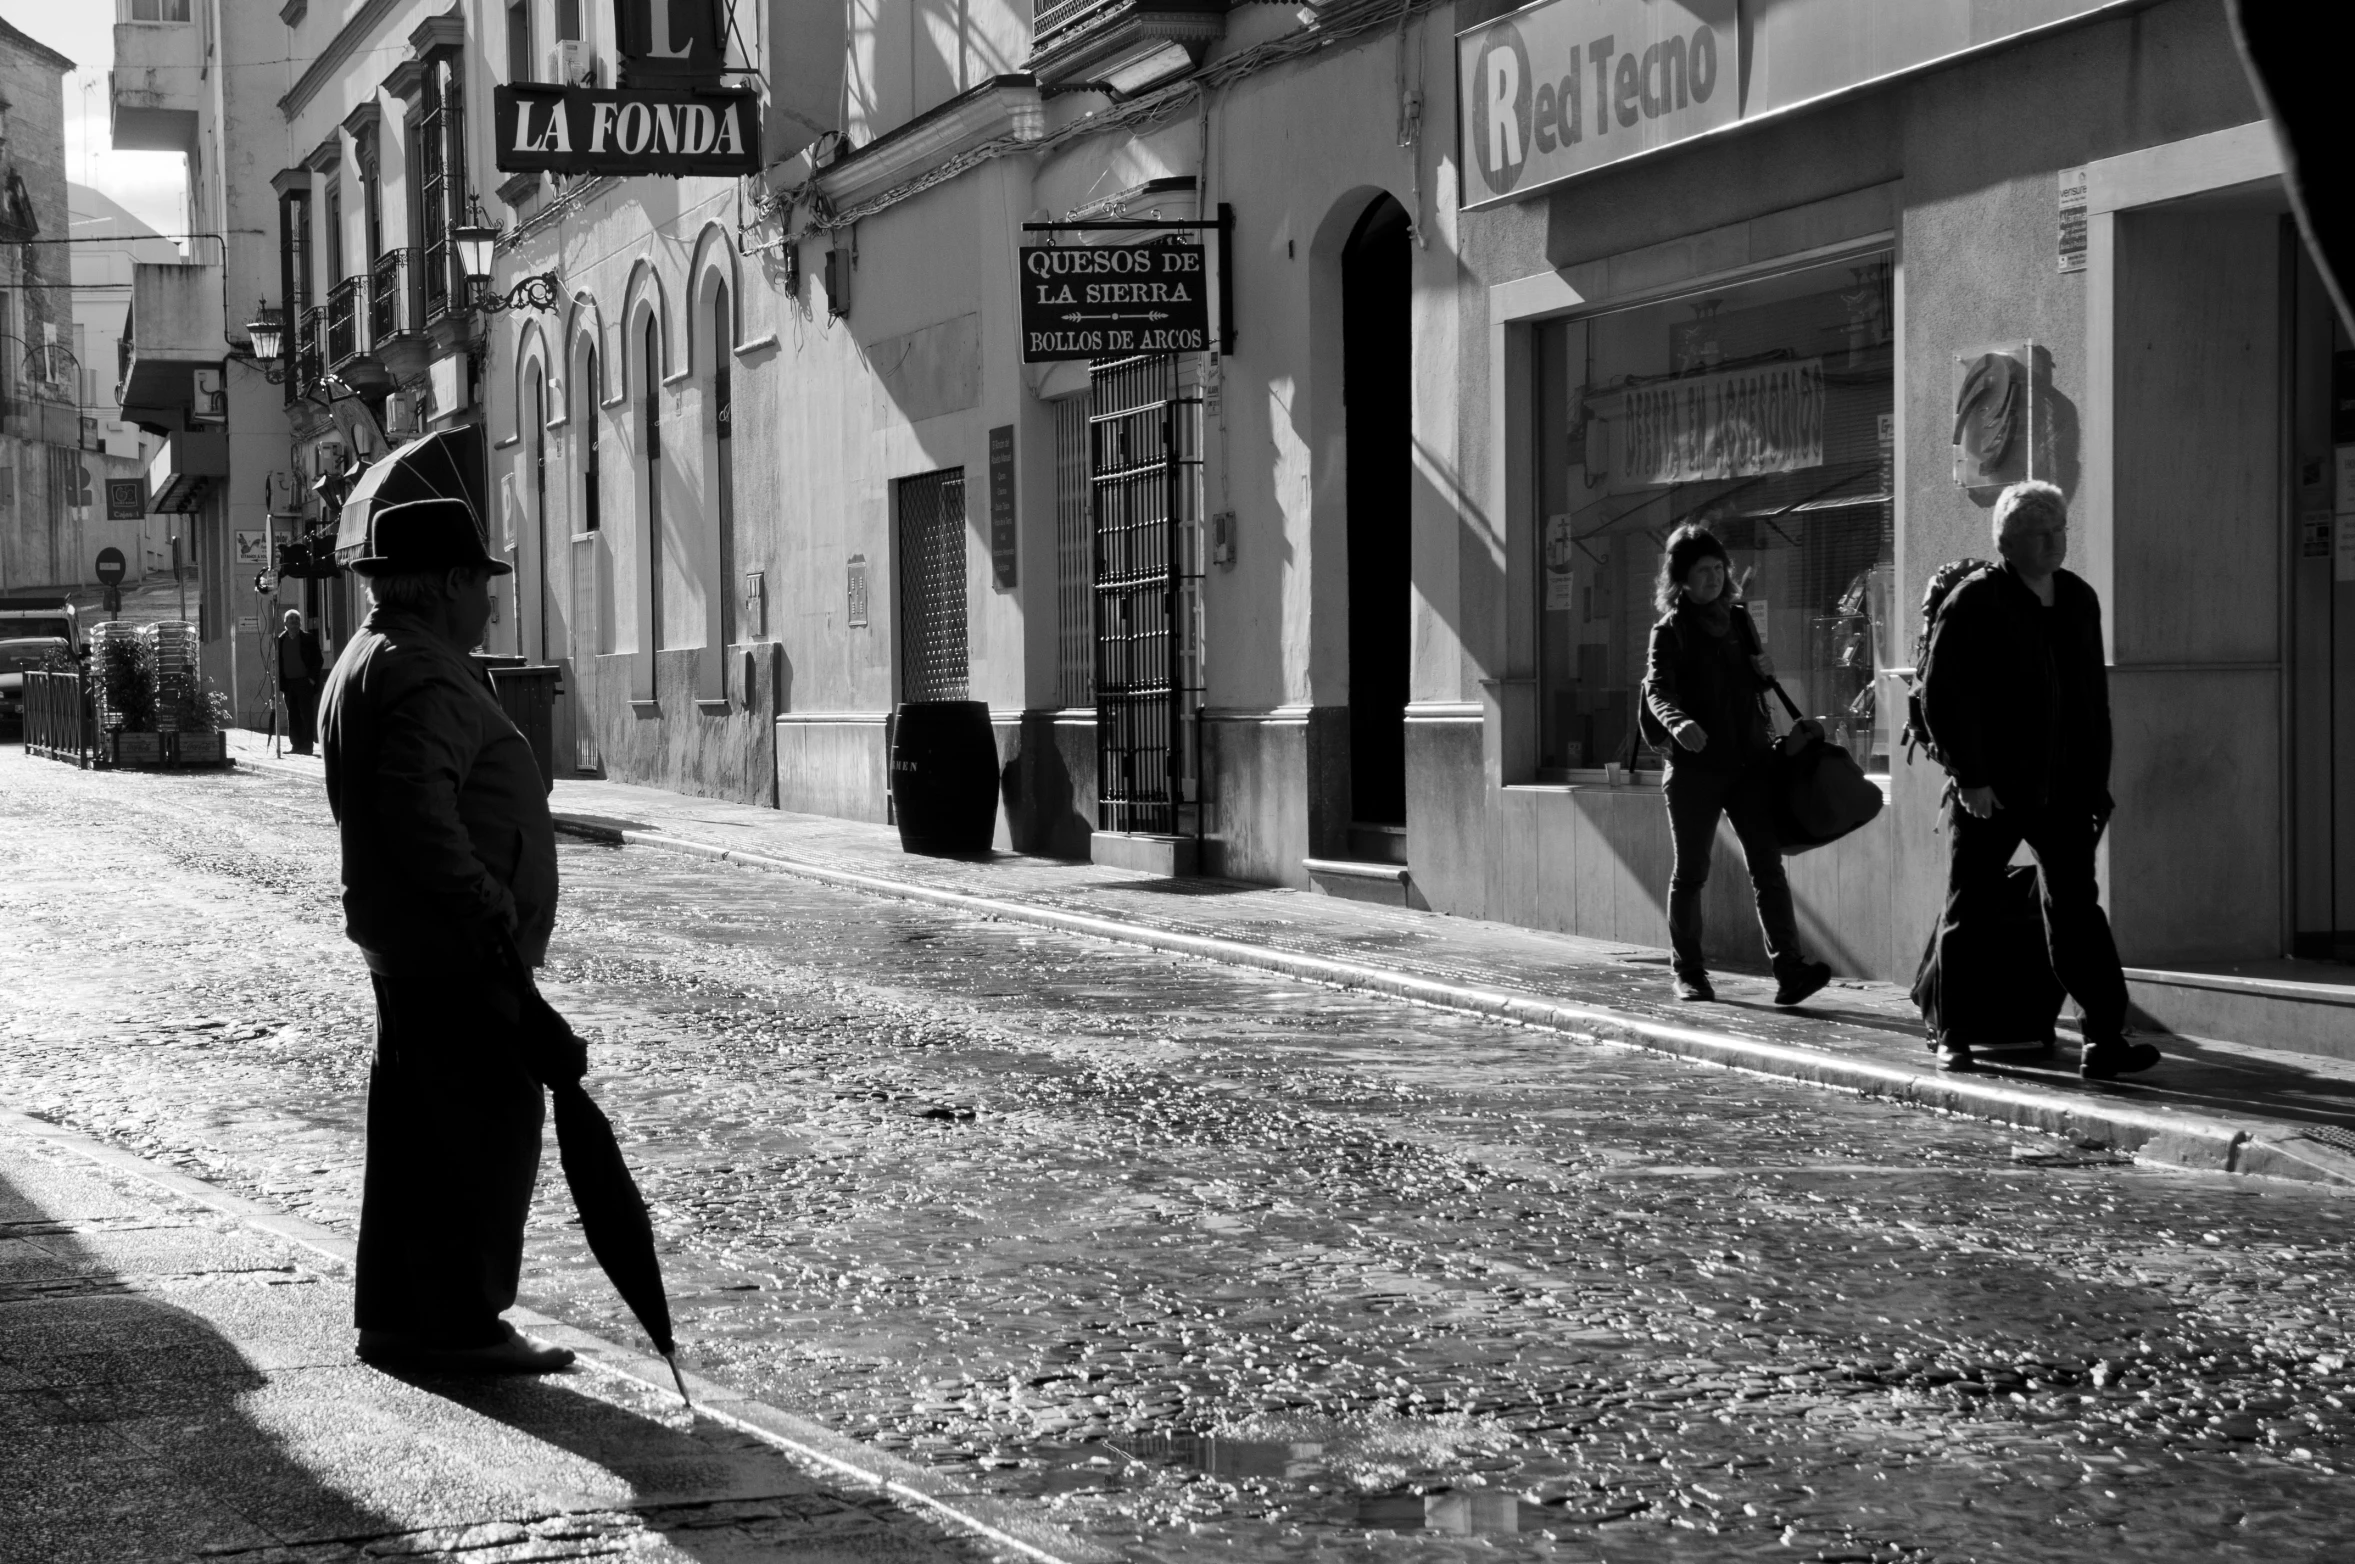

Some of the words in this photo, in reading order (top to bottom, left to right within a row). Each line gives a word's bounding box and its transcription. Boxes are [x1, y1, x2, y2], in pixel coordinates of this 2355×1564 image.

[1487, 44, 1582, 172] Red
[1589, 25, 1717, 136] Tecno
[512, 98, 573, 152] LA
[588, 101, 745, 155] FONDA
[1027, 250, 1151, 279] QUESOS
[1162, 253, 1200, 272] DE
[1036, 284, 1077, 304] LA
[1086, 282, 1192, 304] SIERRA
[1030, 331, 1102, 352] BOLLOS
[1108, 330, 1134, 350] DE
[1139, 329, 1202, 350] ARCOS
